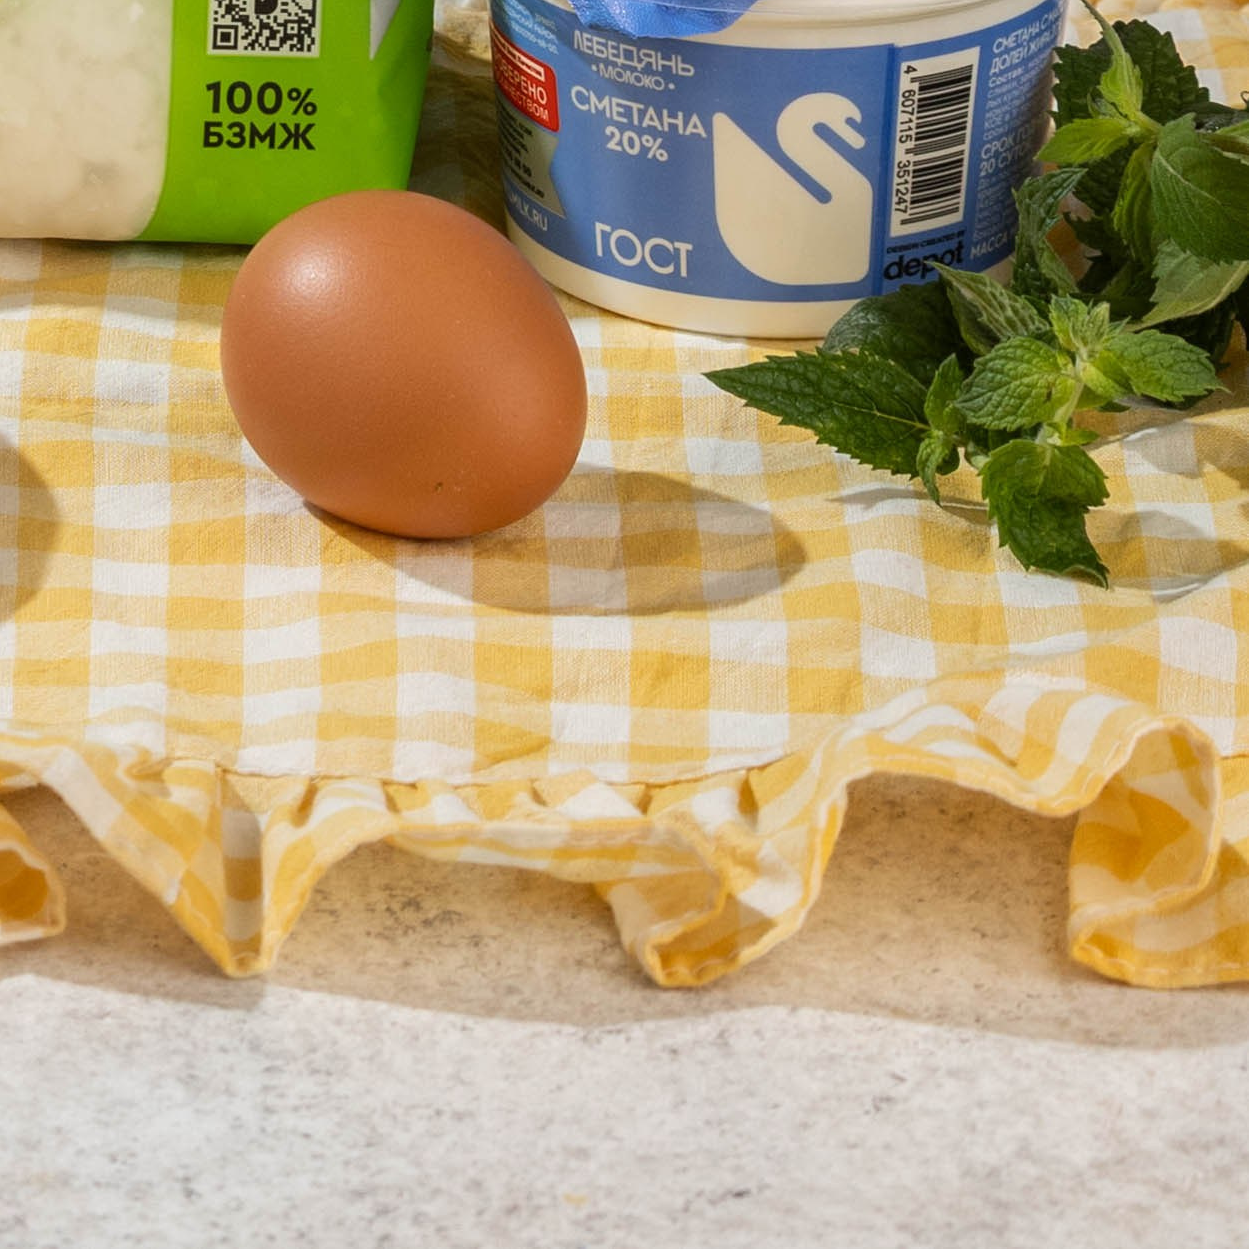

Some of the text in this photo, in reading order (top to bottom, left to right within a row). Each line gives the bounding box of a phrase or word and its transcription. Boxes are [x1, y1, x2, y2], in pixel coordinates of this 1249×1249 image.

[573, 30, 695, 76] ЛЕБЕДЯНЬ
[206, 81, 317, 116] 100%
[599, 64, 665, 90] МОЛОКО
[571, 85, 707, 138] СМЕТАНА
[898, 89, 916, 144] 607115
[203, 121, 316, 150] БЗМЖ
[604, 126, 669, 162] 20%
[894, 160, 911, 214] 351247
[595, 222, 693, 278] ГОСТ
[883, 239, 965, 281] depot
